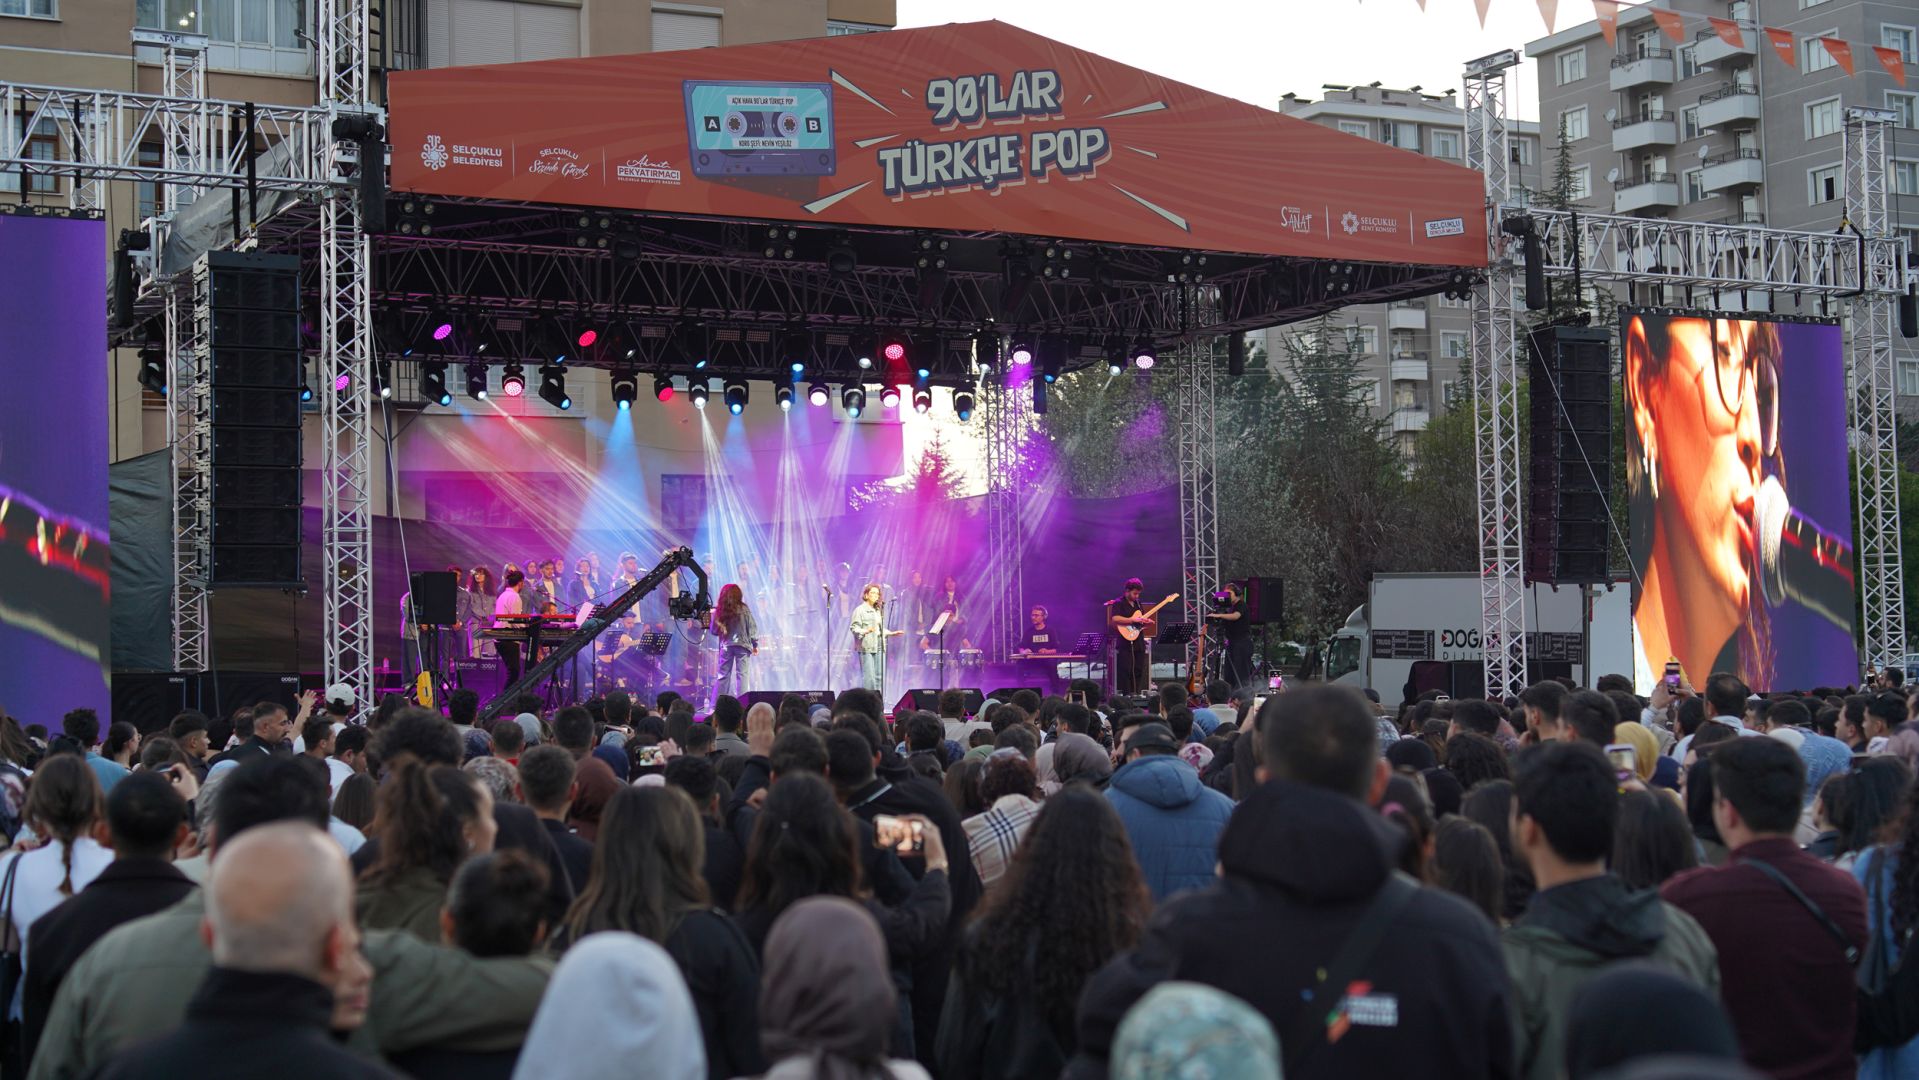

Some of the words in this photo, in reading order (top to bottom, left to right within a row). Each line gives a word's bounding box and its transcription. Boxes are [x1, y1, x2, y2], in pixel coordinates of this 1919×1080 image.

[926, 69, 1061, 123] 90'LAR
[707, 118, 719, 130] A
[808, 119, 819, 131] B
[452, 144, 502, 157] SELÇUKLU
[453, 156, 503, 167] BELEDİYESİ
[878, 134, 1022, 192] TÜRKÇE
[1030, 127, 1107, 173] POP
[618, 167, 680, 180] PEKYATIRMACI
[1360, 216, 1397, 227] SELÇUKLU
